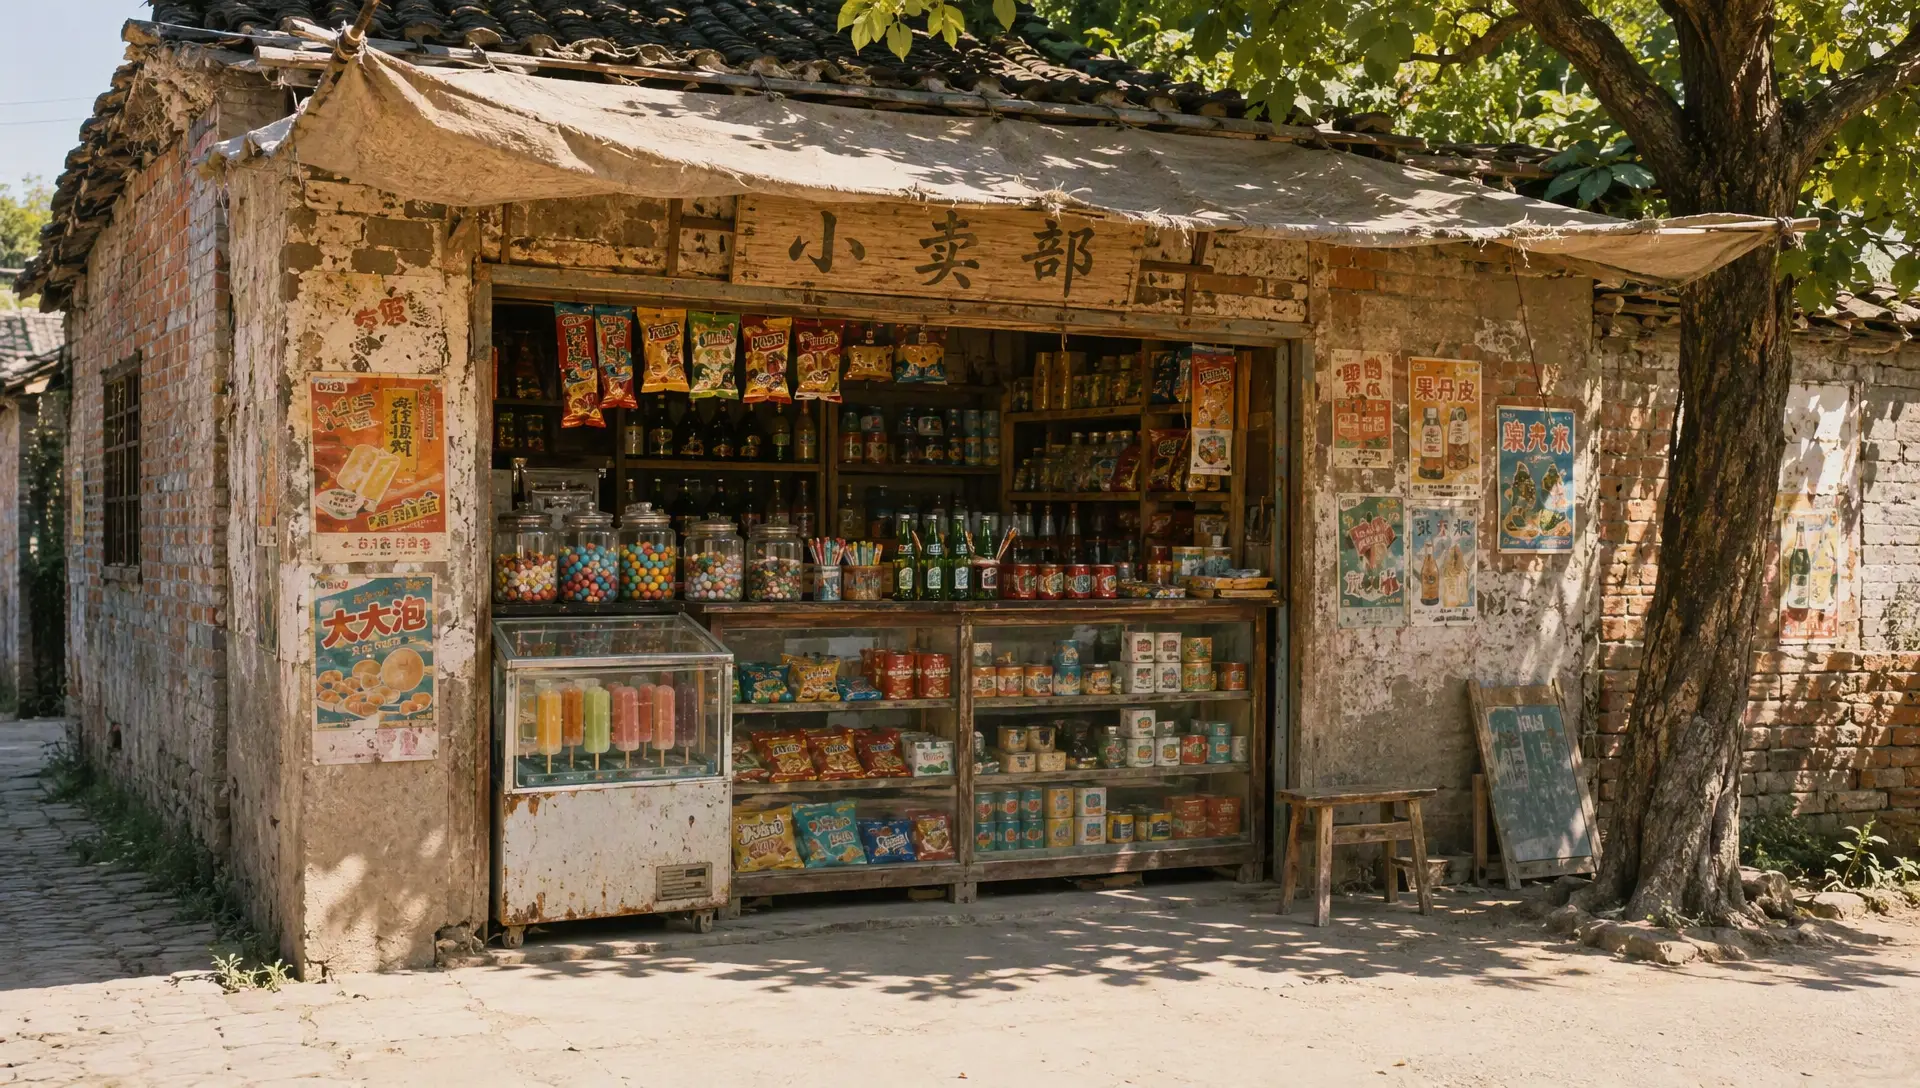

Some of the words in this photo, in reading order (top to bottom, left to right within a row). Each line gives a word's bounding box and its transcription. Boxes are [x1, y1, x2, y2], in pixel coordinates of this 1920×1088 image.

[789, 209, 1095, 298] 小卖部
[1415, 377, 1475, 402] 果丹皮
[321, 595, 427, 649] 大大泡
